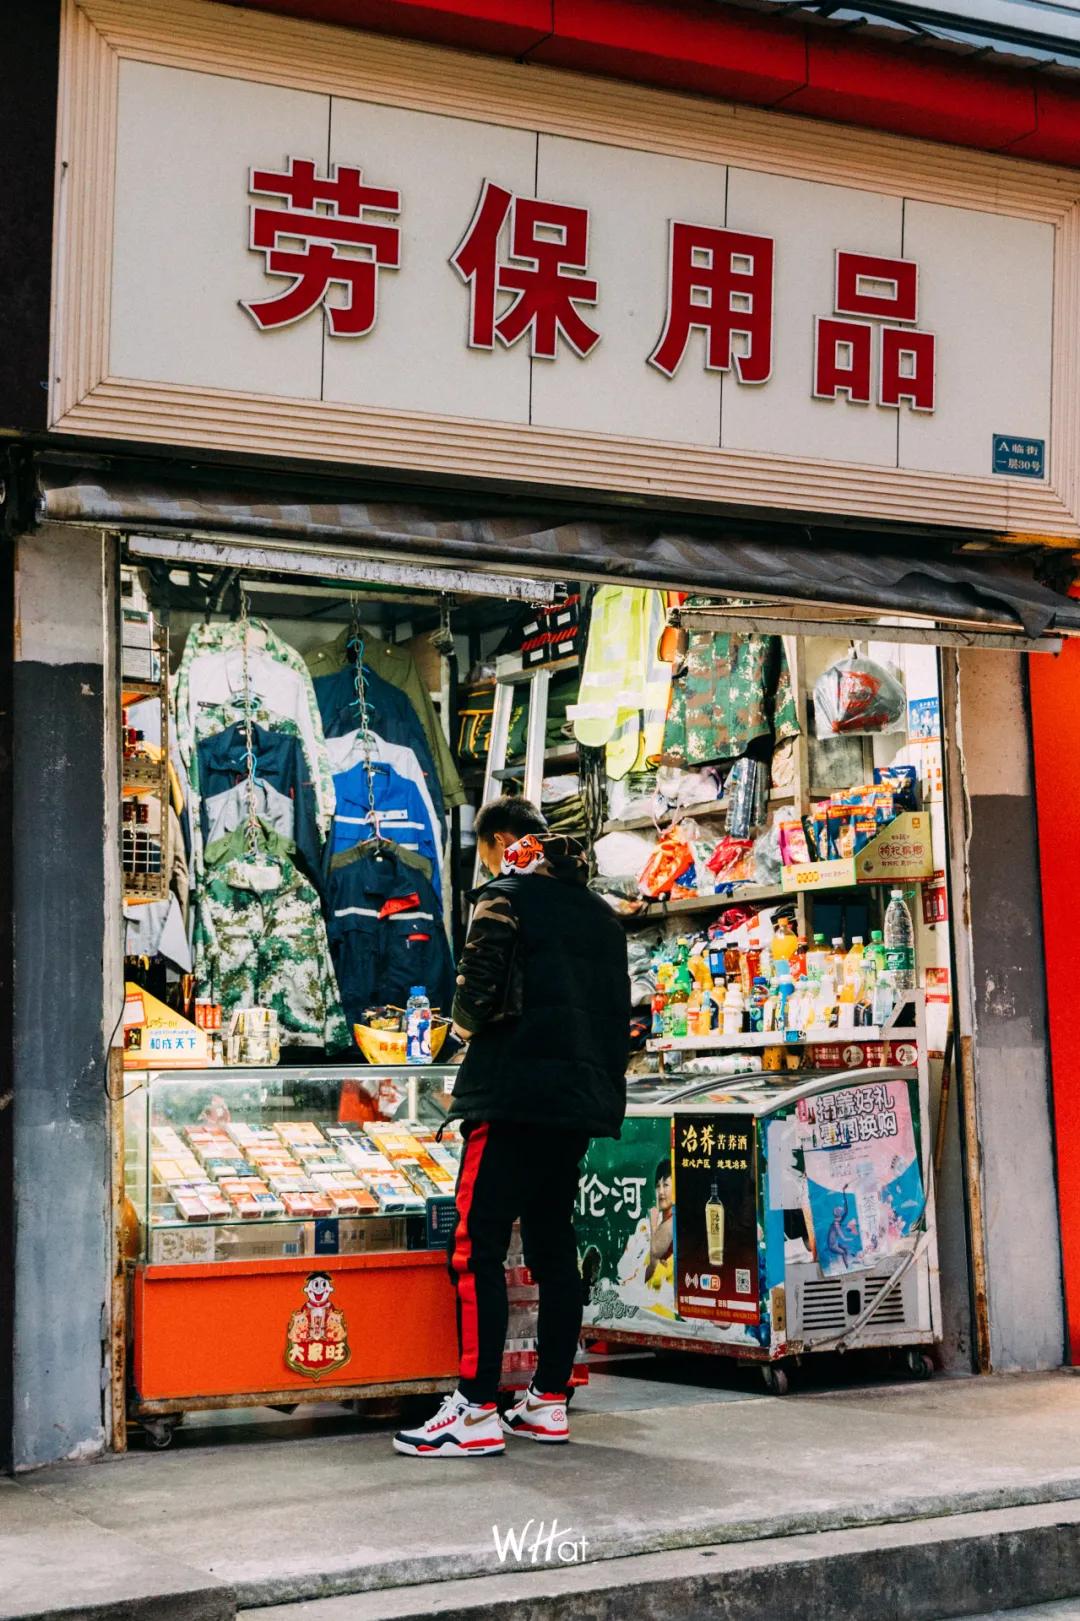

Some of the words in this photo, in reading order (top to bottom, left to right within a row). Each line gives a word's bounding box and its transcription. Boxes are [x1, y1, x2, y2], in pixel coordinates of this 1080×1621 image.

[239, 156, 937, 415] 劳保用品
[150, 1037, 197, 1050] 和成天下
[817, 1084, 895, 1121] 揭盖好礼
[578, 1173, 647, 1220] 伦河
[289, 1342, 345, 1362] 大家旺
